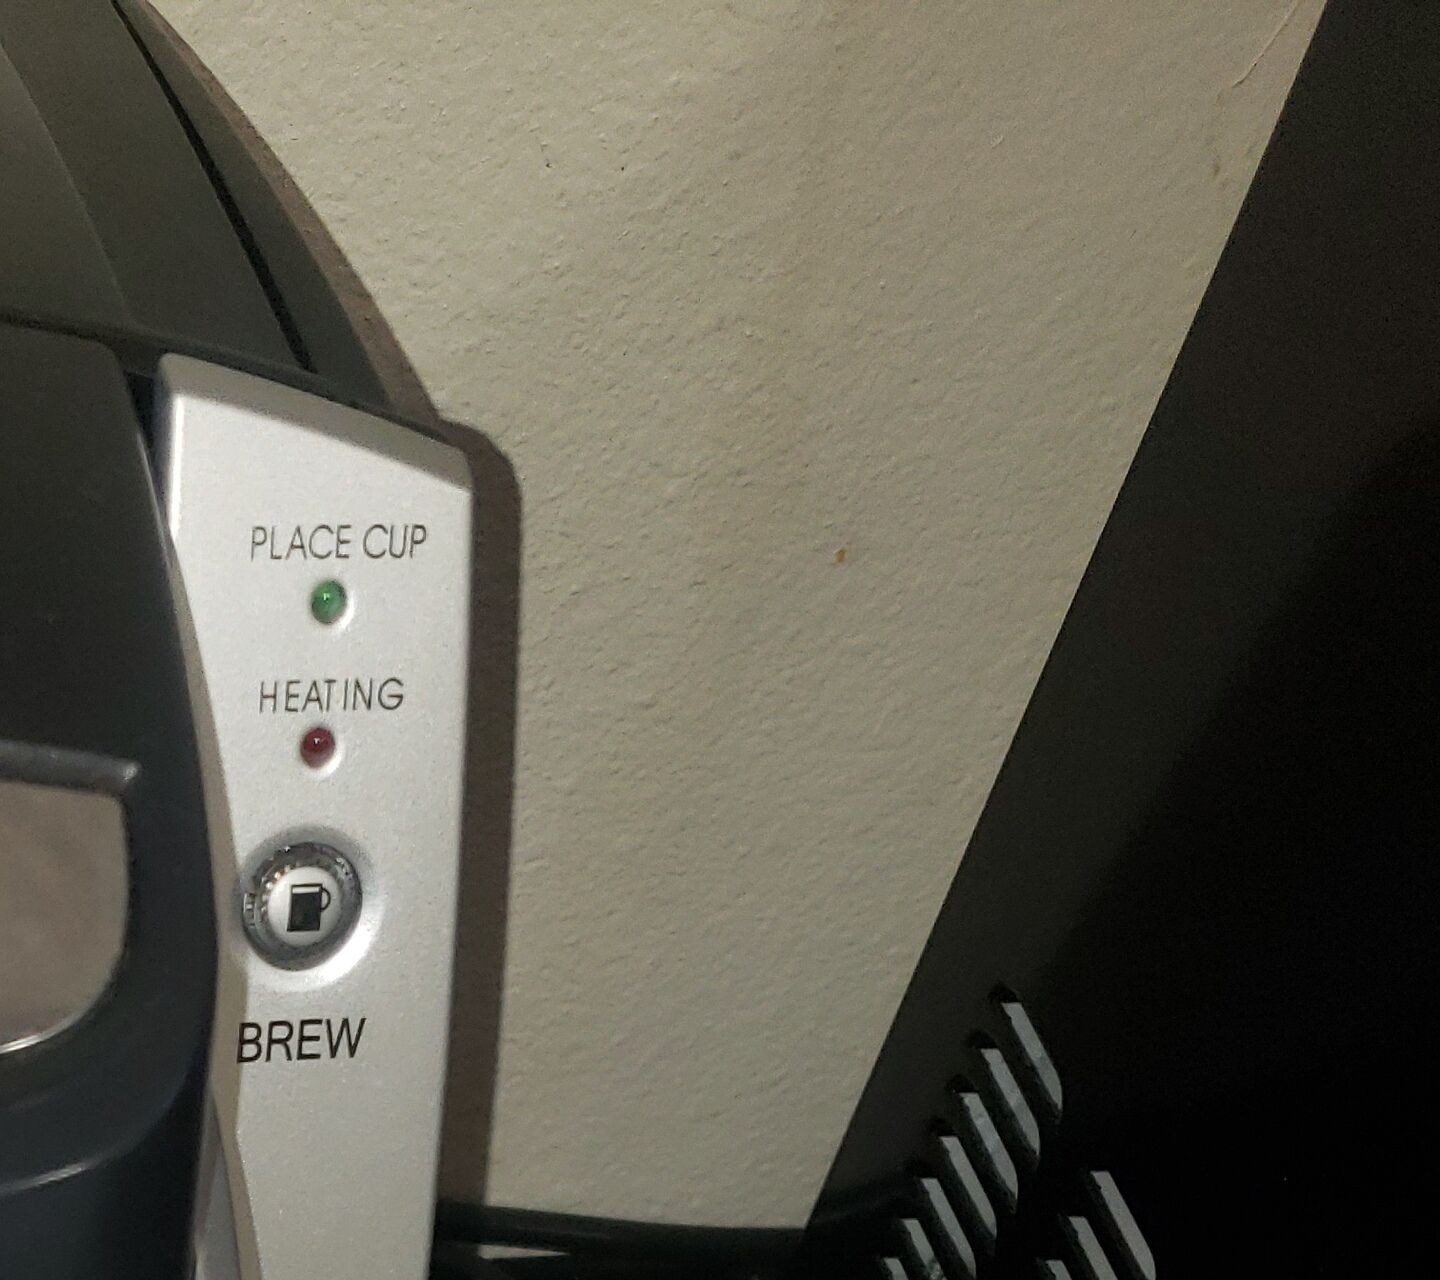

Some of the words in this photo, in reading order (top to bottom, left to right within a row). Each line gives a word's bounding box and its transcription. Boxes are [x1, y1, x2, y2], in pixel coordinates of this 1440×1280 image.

[251, 524, 352, 562] PLACE
[361, 523, 428, 560] CUP
[259, 676, 405, 714] HEATING
[236, 1016, 366, 1065] BREW
